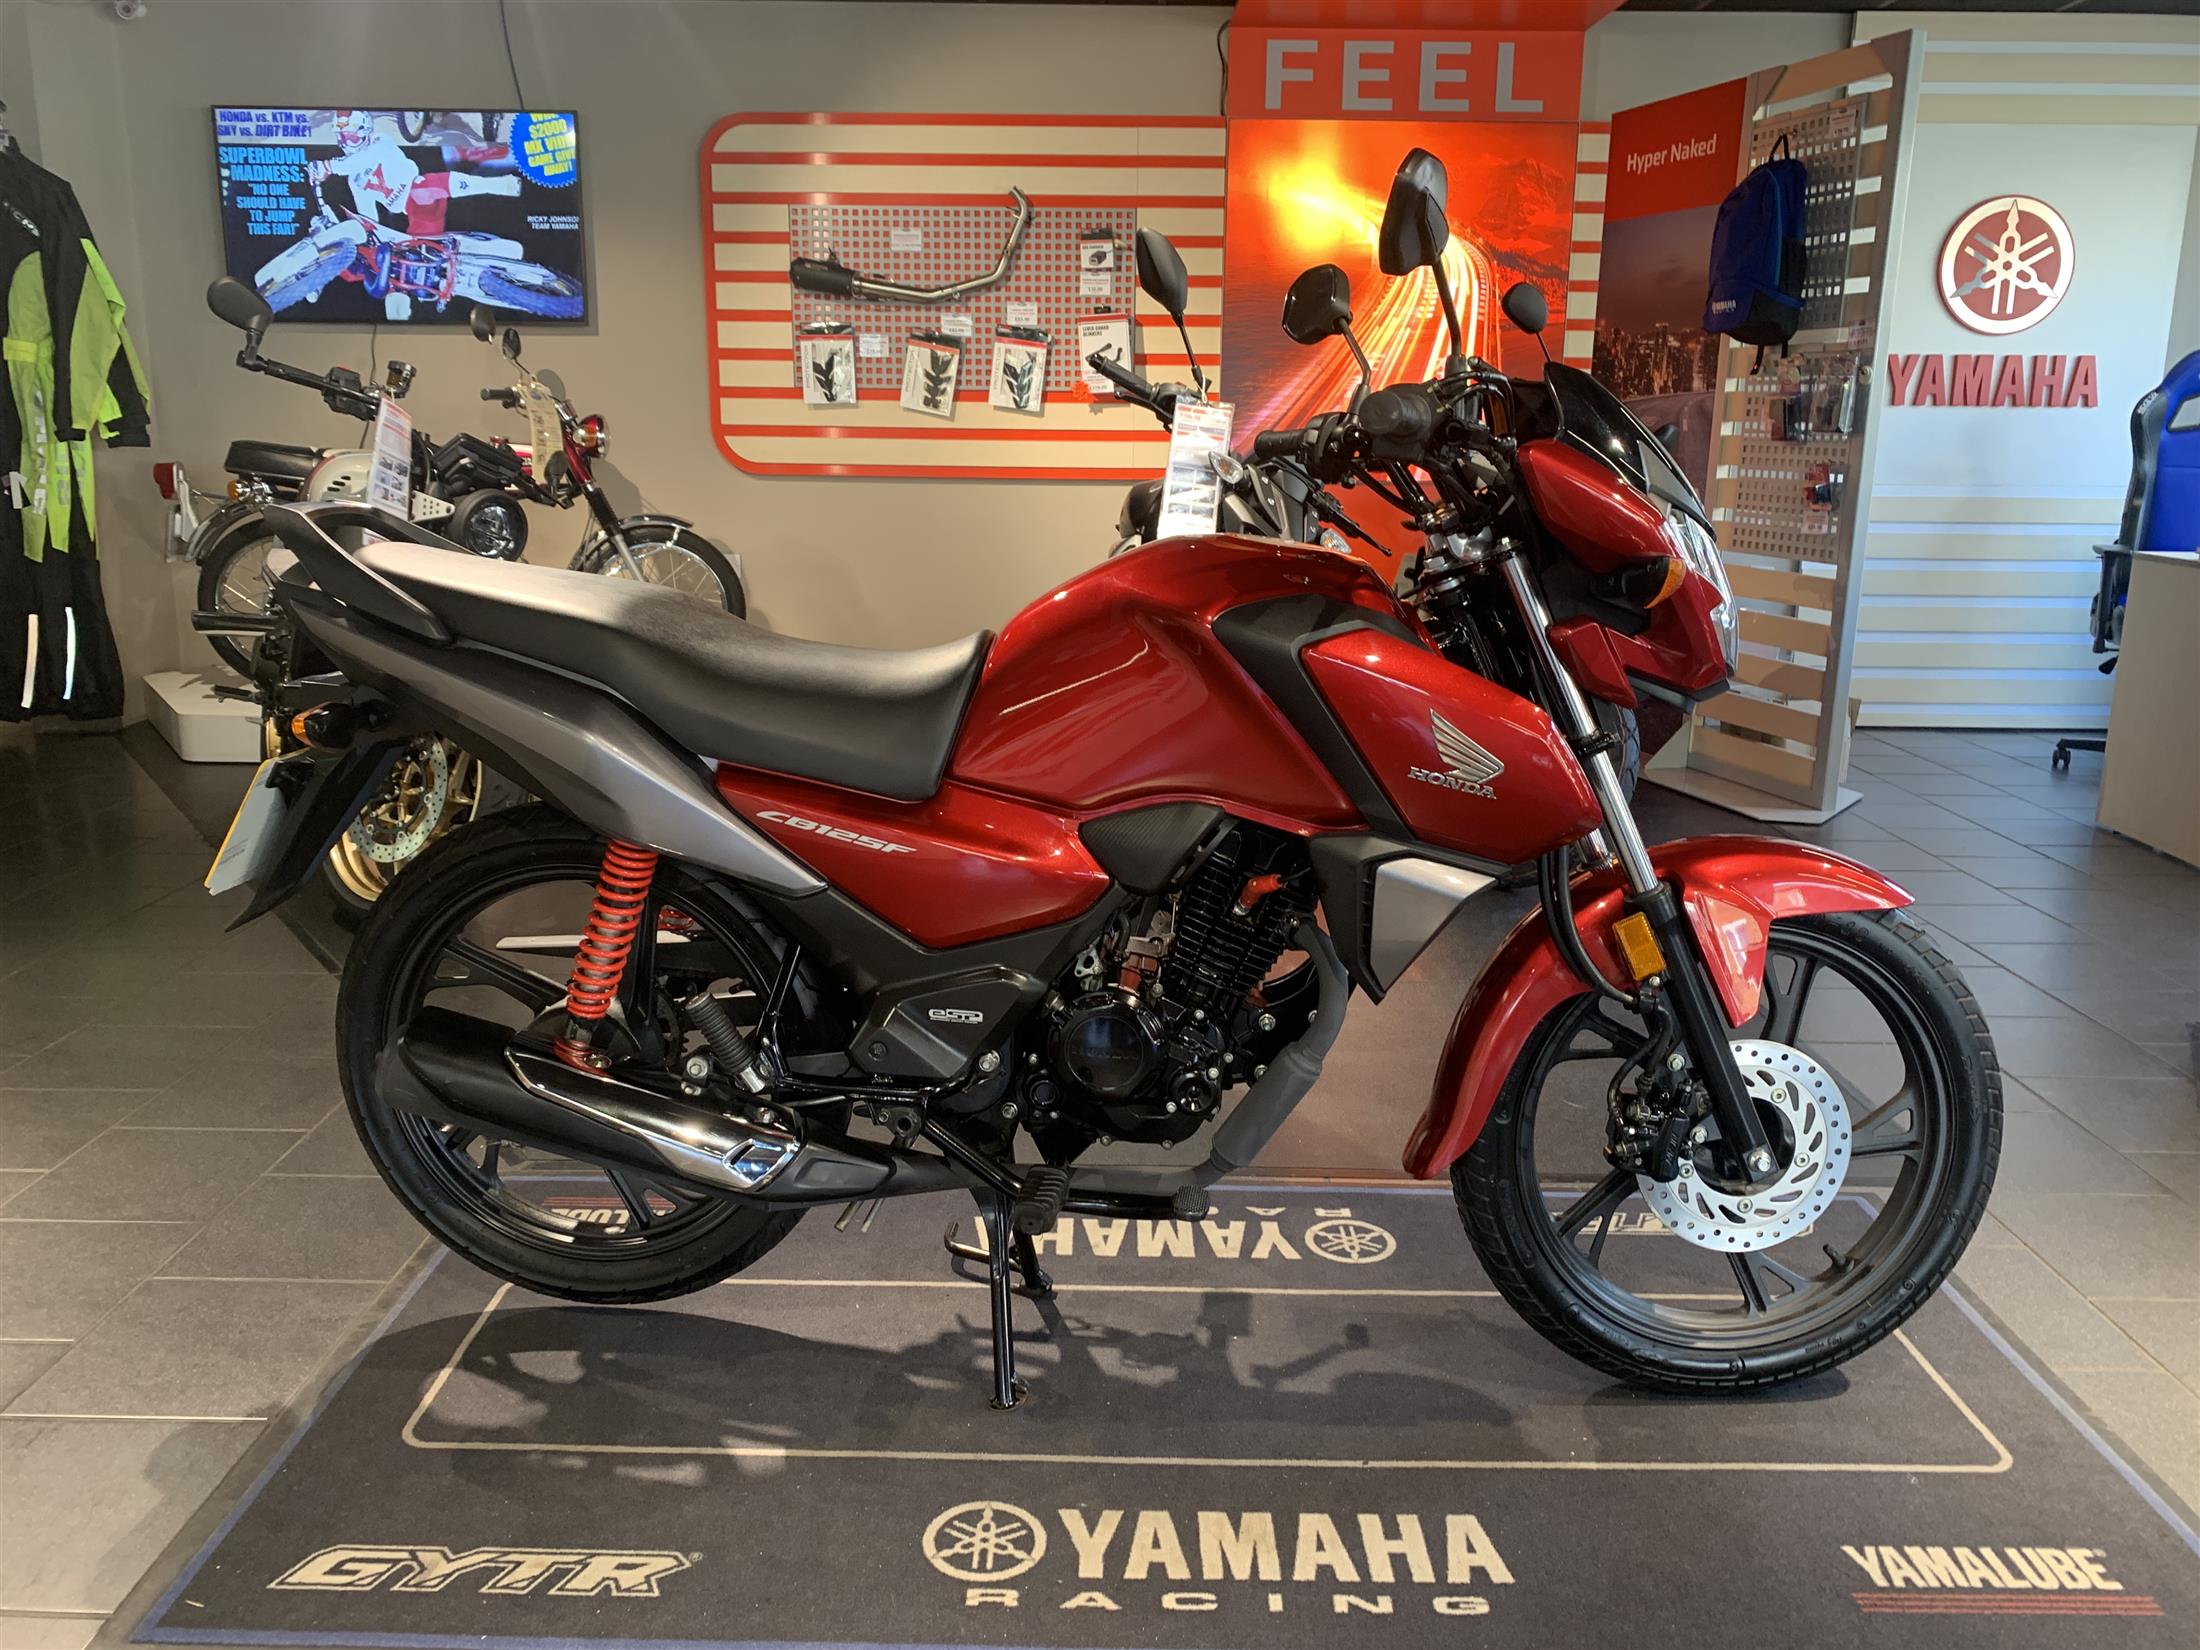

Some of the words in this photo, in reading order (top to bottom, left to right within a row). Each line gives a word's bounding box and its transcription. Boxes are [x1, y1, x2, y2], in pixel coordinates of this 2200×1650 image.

[1265, 39, 1543, 112] FEEL
[220, 111, 253, 122] HONDA
[272, 111, 293, 122] KTM
[256, 125, 281, 137] DIRT
[219, 146, 308, 165] SUPERBOWL
[1627, 152, 1667, 175] Hyper
[1670, 133, 1717, 163] Naked
[230, 164, 305, 182] MADNESS:
[269, 183, 290, 196] ONE
[236, 196, 277, 209] SHOULD
[279, 197, 306, 210] HAVE
[249, 210, 263, 222] TO
[265, 210, 295, 222] JUMP
[527, 215, 548, 223] RICKY
[247, 222, 271, 235] THIS
[531, 222, 550, 230] TEAM
[551, 222, 579, 230] YAMAHA
[1888, 354, 2098, 408] YAMAHA
[1408, 766, 1497, 800] HONDA
[756, 811, 918, 853] CB125F
[1059, 1508, 1516, 1584] YAMAHA
[267, 1544, 693, 1597] GYTR
[1840, 1545, 2124, 1591] YAMALUBE
[964, 1587, 1491, 1616] RACING
